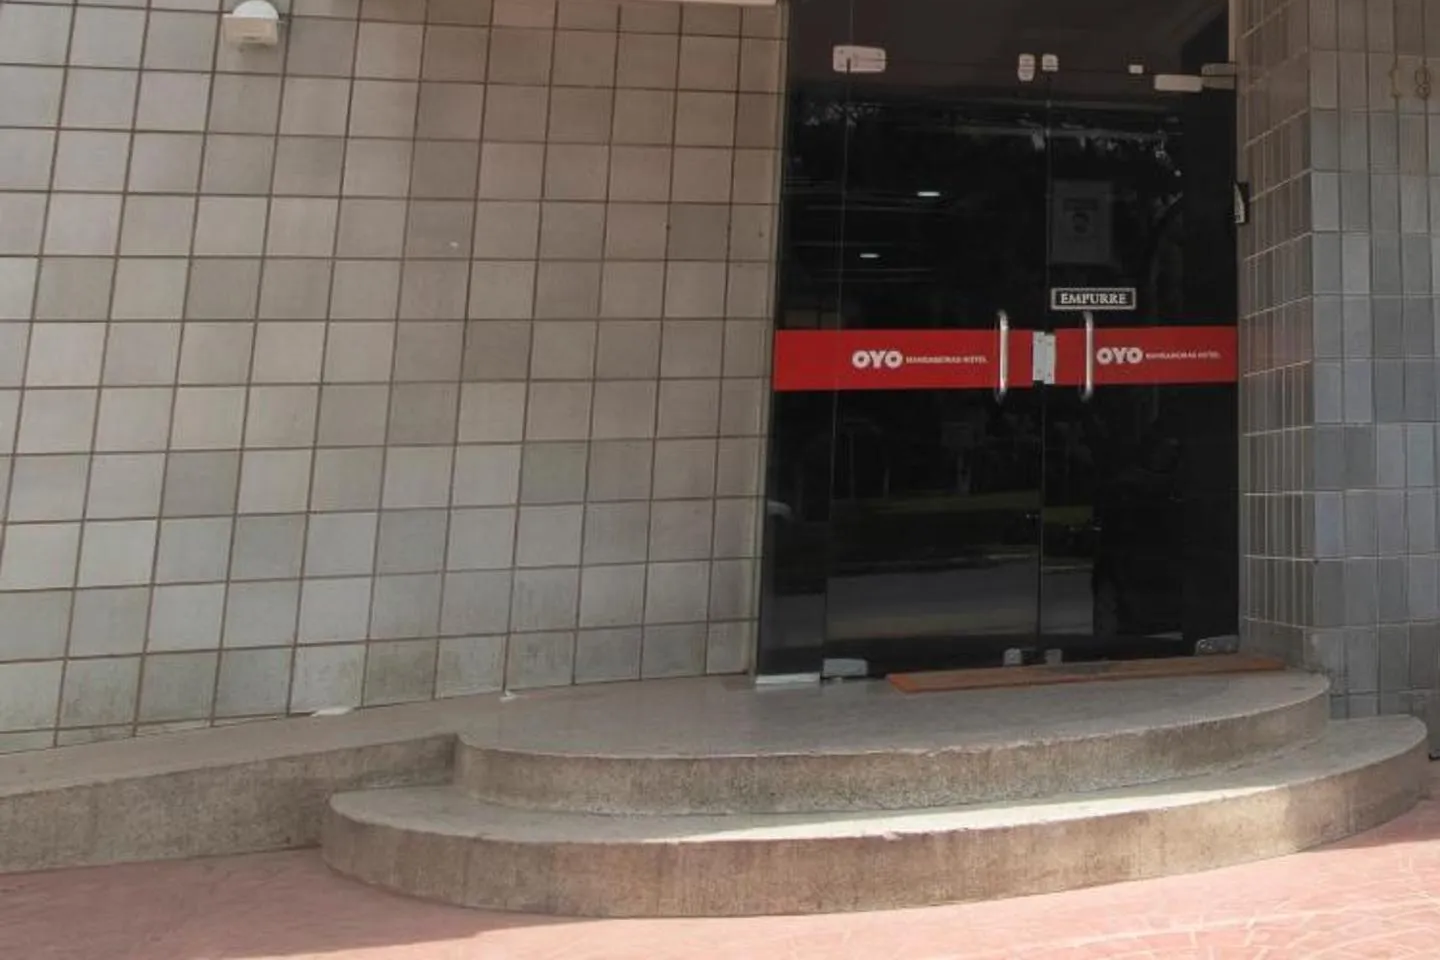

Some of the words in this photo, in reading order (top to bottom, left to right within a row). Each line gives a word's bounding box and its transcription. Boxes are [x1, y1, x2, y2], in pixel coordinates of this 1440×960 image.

[1060, 292, 1129, 305] EMPURRE
[852, 350, 903, 369] OYO
[1096, 347, 1143, 365] OYO
